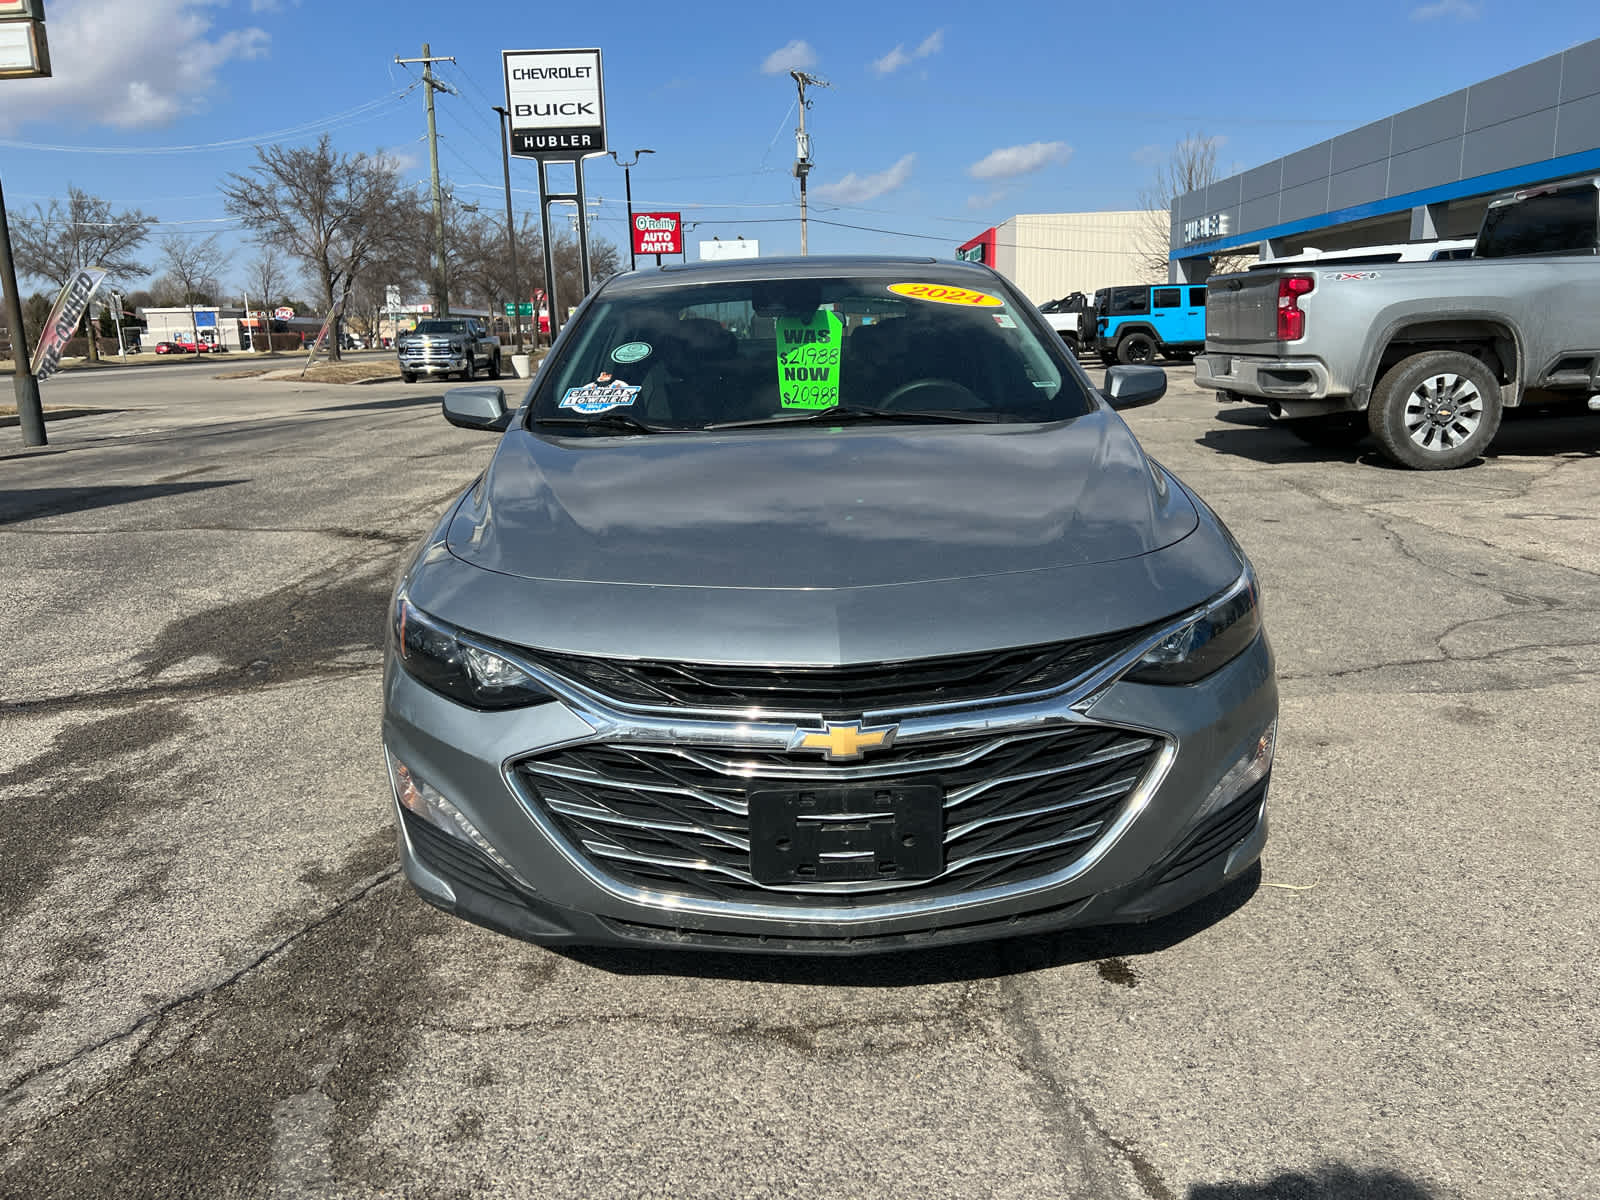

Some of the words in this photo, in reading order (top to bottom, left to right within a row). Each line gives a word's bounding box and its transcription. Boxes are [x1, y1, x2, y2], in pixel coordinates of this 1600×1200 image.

[513, 66, 592, 80] CHEVROLET
[515, 102, 595, 117] BUICK
[524, 135, 592, 148] HUBLER
[636, 216, 676, 231] O'Reilly
[643, 232, 672, 242] AUTO
[641, 242, 675, 252] PARTS
[907, 286, 985, 304] 2024
[783, 328, 832, 344] WAS
[784, 367, 830, 381] NOW
